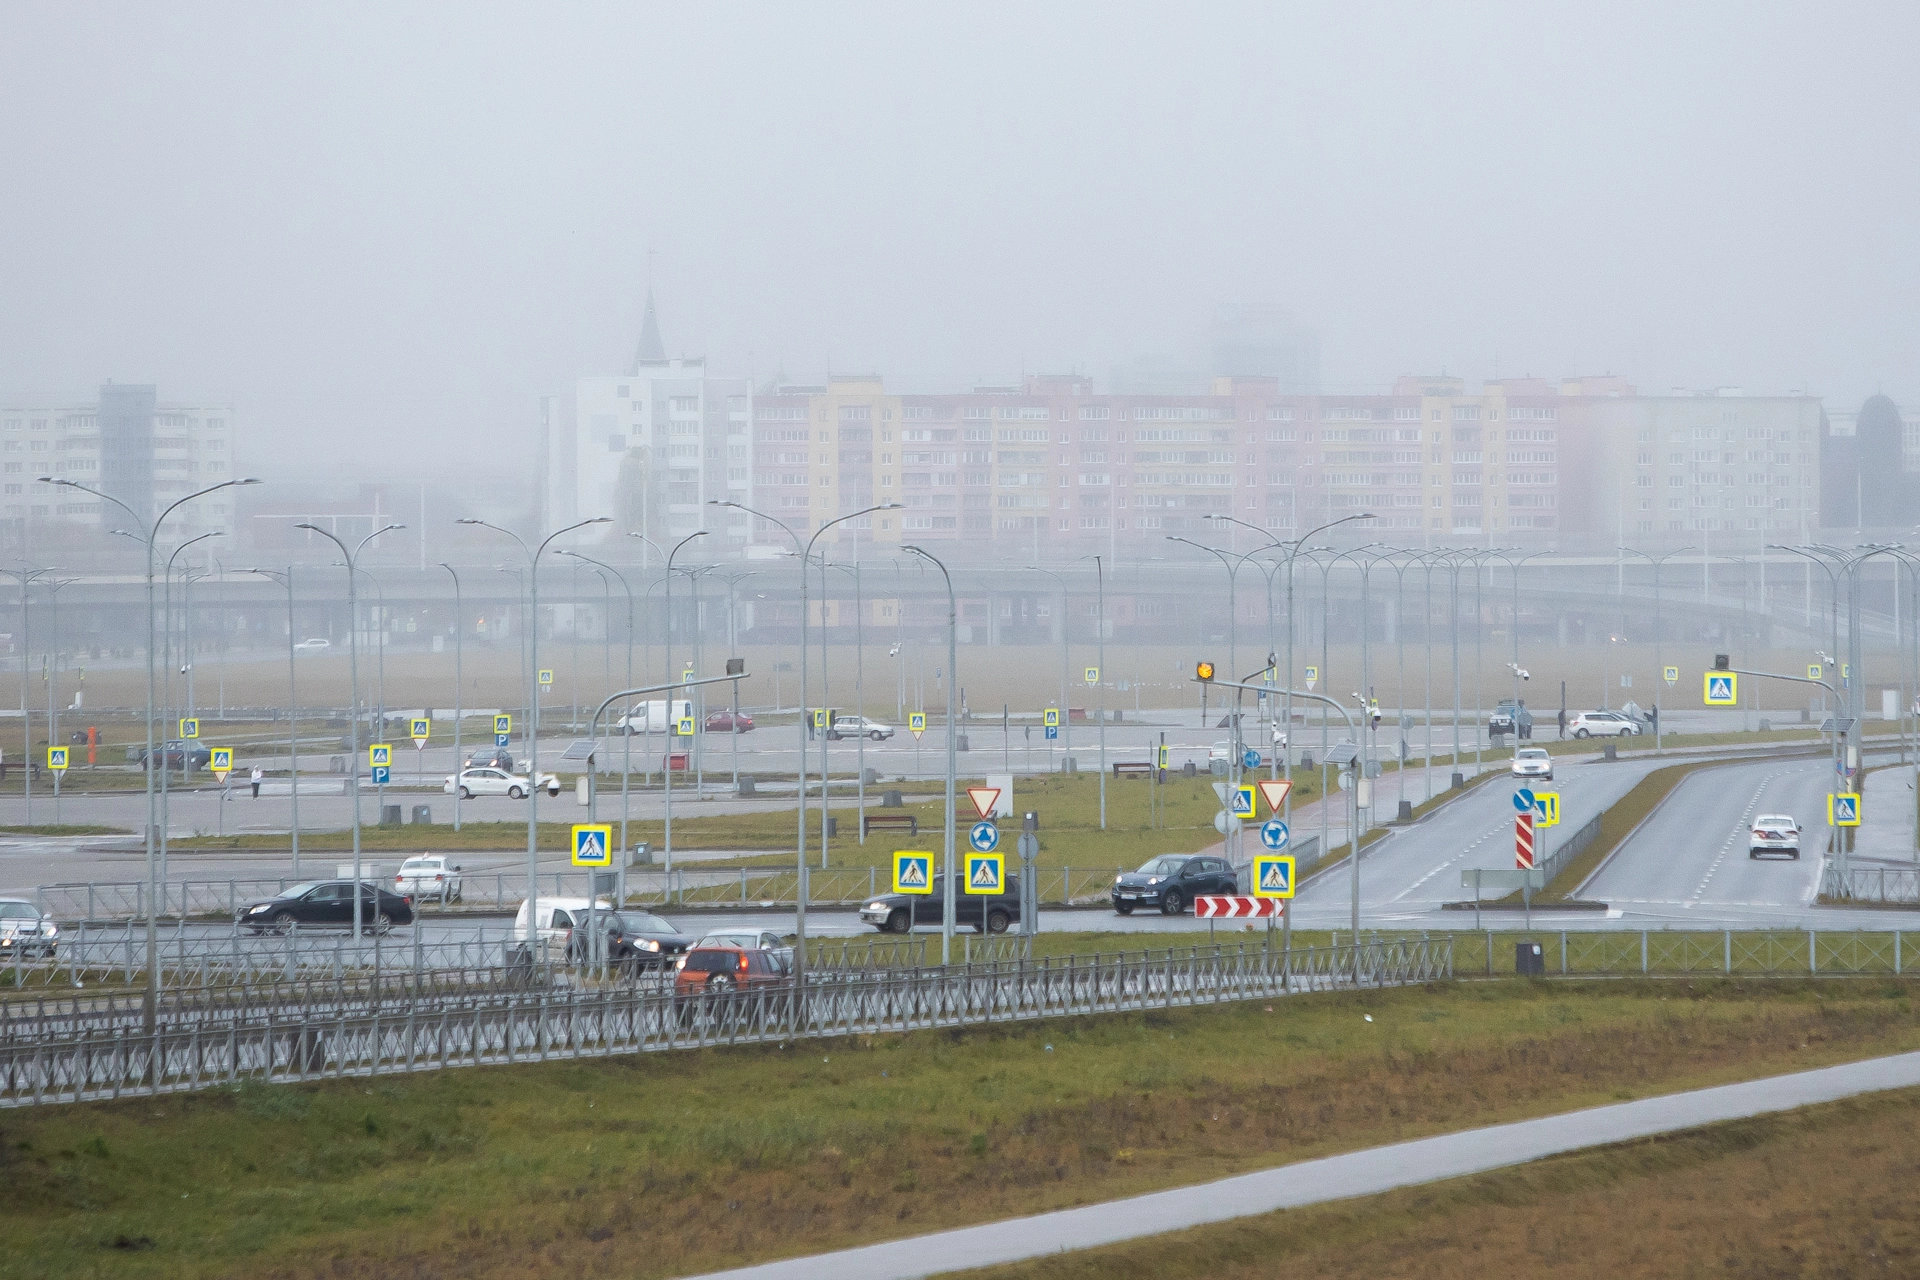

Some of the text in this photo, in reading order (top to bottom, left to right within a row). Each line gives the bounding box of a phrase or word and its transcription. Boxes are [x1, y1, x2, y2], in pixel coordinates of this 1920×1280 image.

[1048, 727, 1056, 738] P
[498, 734, 506, 746] P
[376, 768, 386, 782] P
